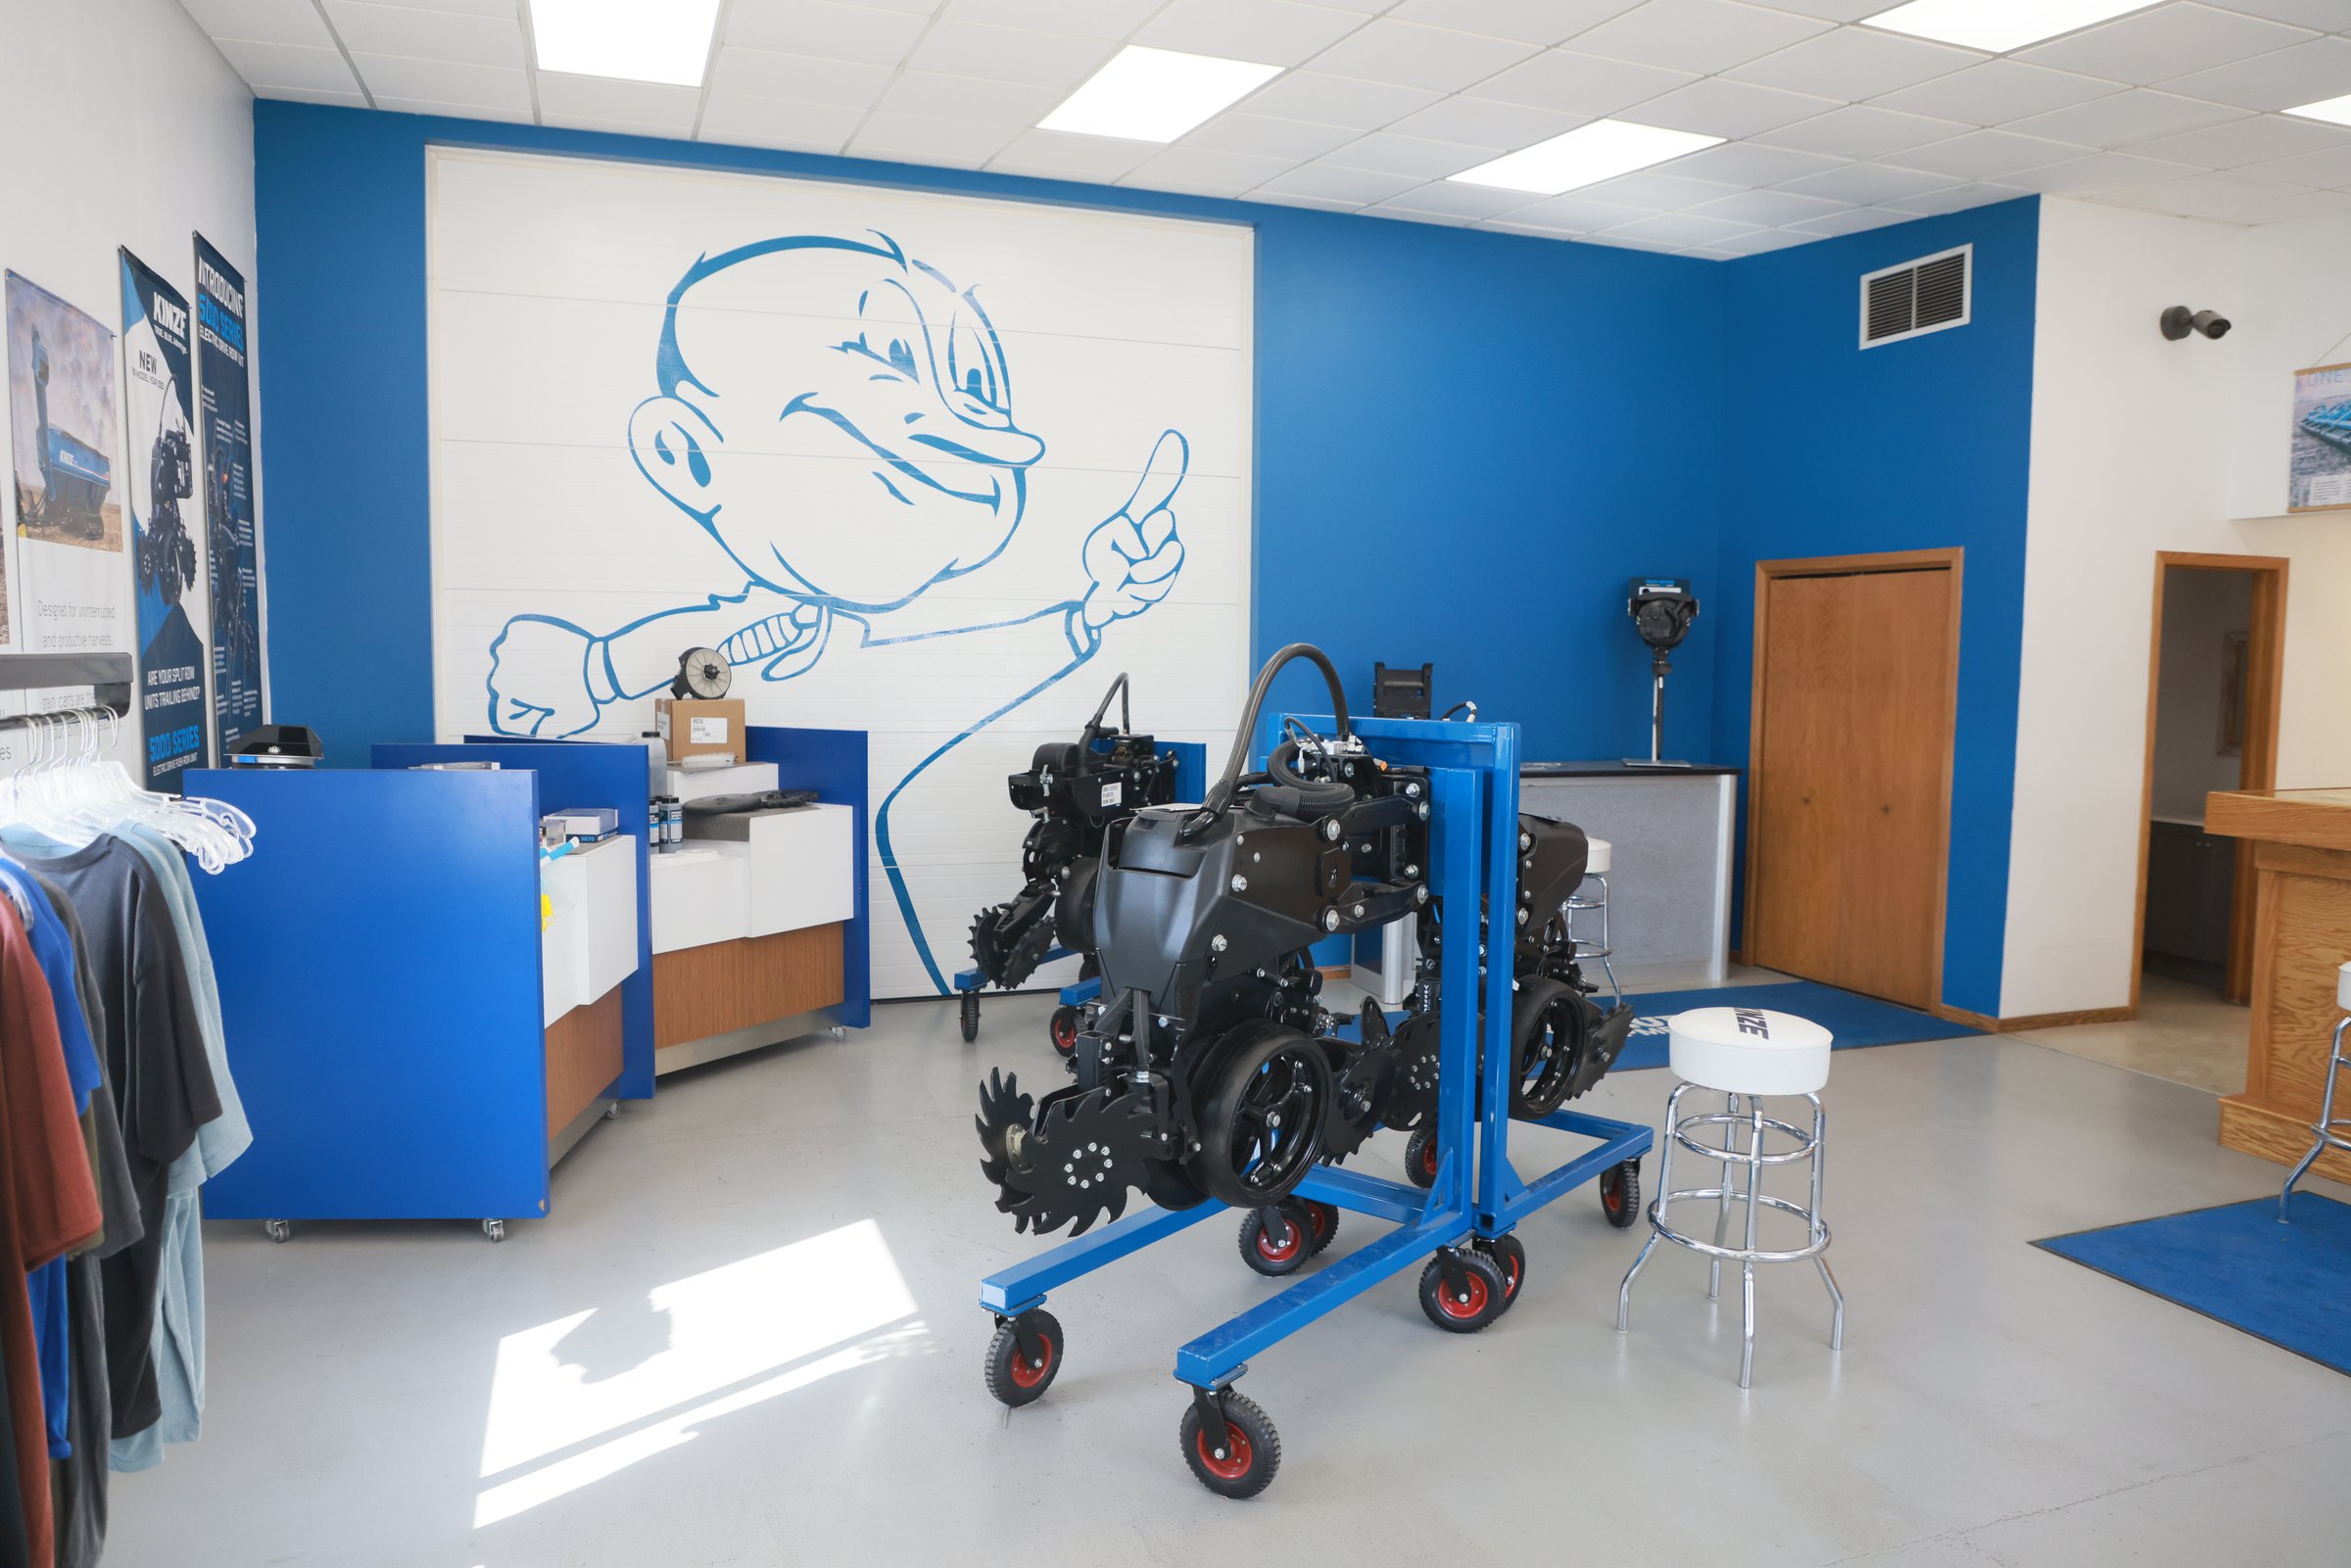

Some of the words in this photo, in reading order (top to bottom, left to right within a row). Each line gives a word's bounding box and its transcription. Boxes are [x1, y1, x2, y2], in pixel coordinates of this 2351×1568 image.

[153, 292, 187, 340] KINZE
[139, 350, 157, 375] NEW
[42, 632, 57, 648] and
[147, 670, 159, 687] ARE
[159, 668, 172, 685] YOUR
[149, 733, 171, 763] 5000
[171, 725, 201, 755] SERIES
